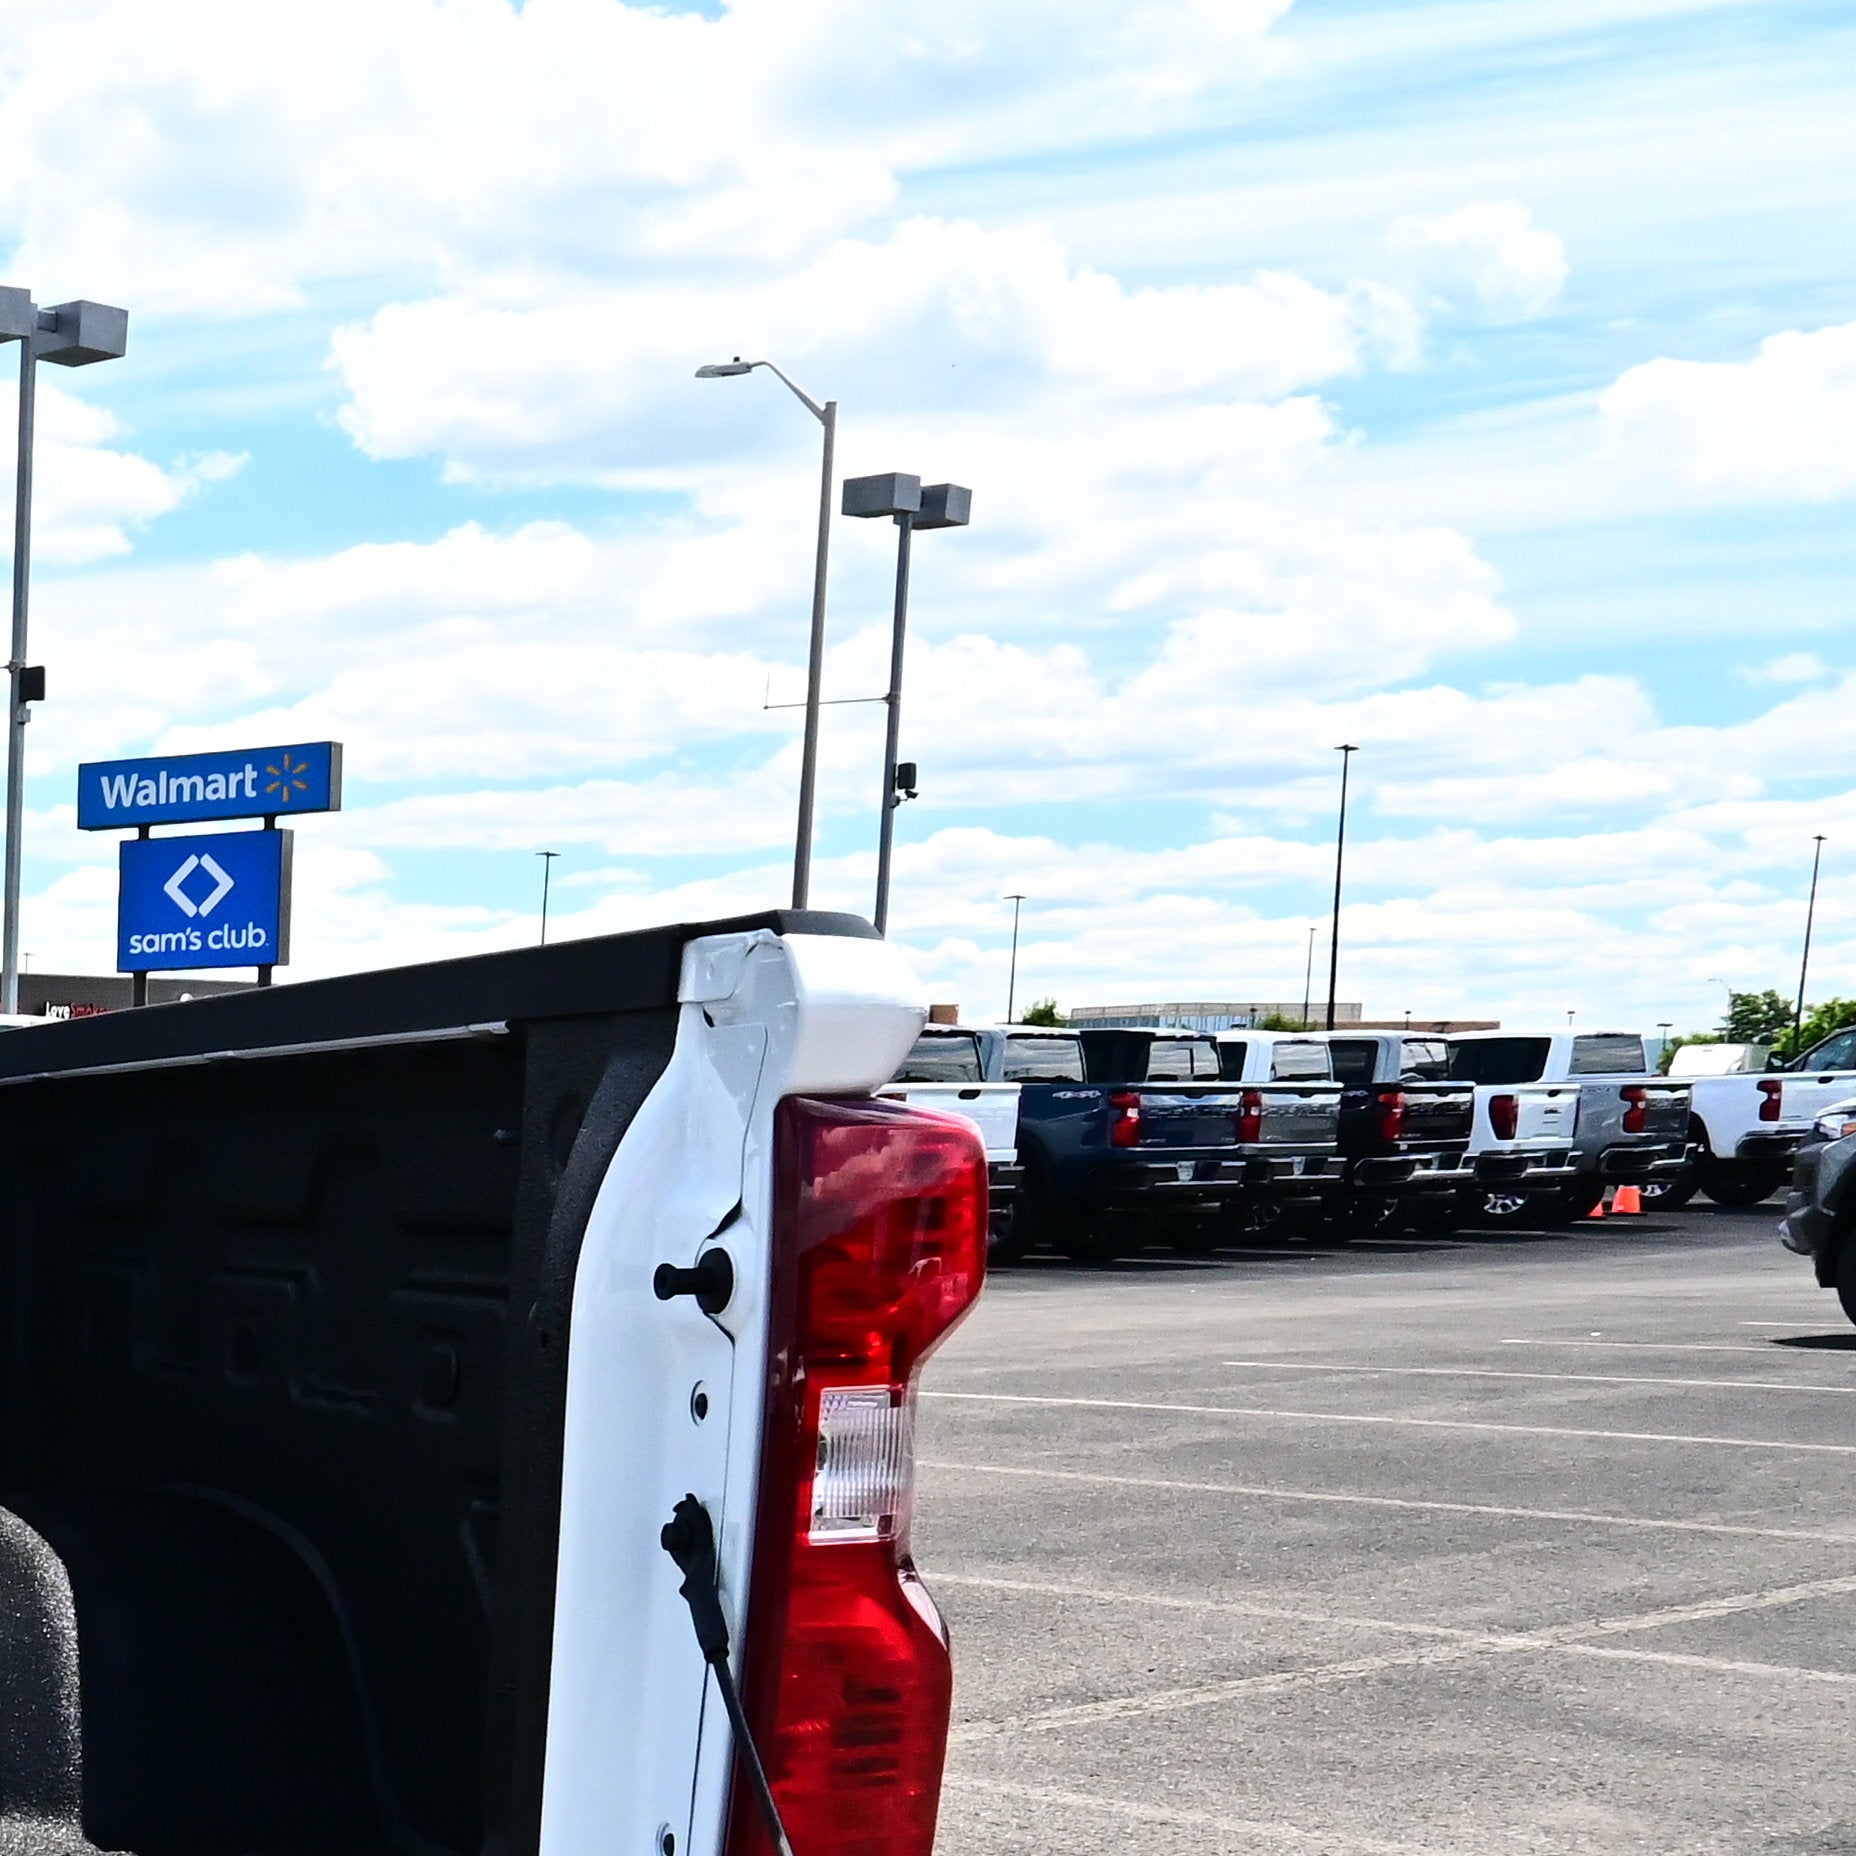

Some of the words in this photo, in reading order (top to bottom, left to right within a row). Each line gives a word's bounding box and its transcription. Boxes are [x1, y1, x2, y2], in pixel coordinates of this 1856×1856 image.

[100, 763, 258, 809] Walmart
[129, 927, 202, 954] sam's
[208, 921, 267, 949] club
